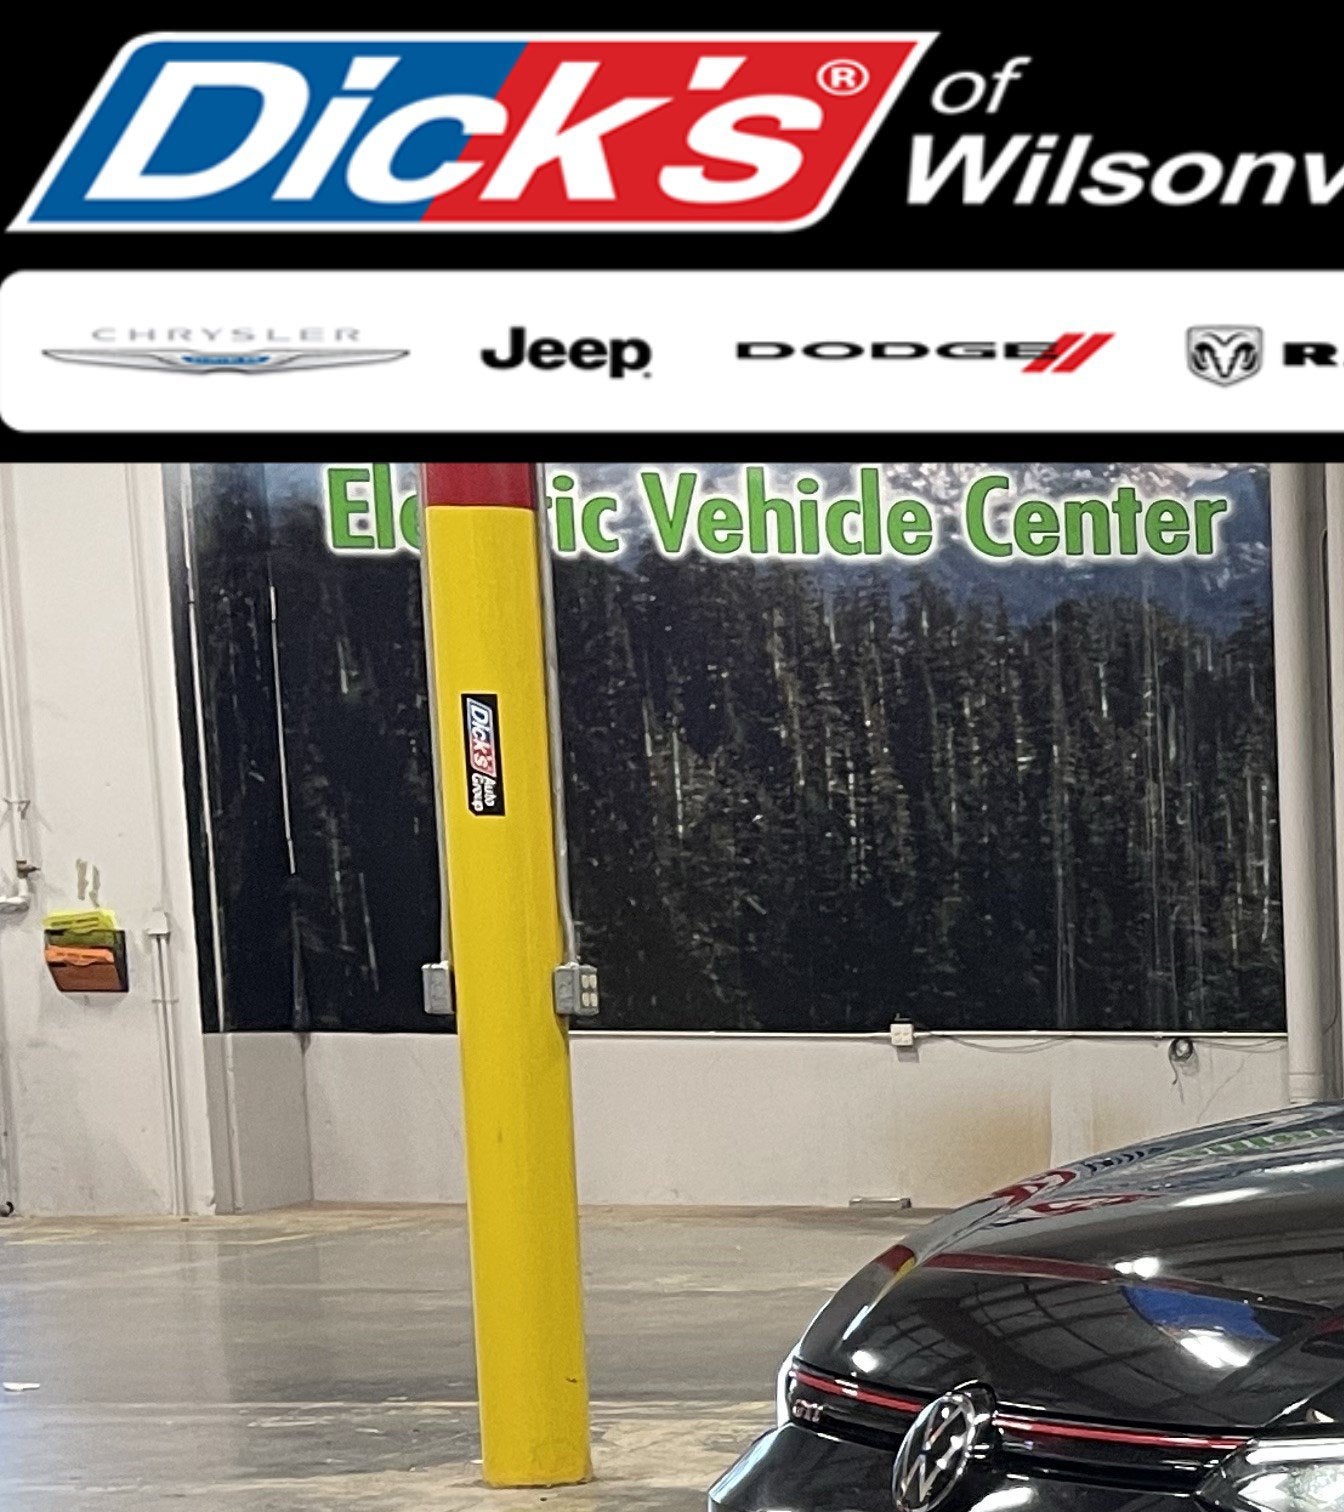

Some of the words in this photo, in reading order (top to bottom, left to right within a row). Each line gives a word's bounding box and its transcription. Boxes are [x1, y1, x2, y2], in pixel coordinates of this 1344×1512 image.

[327, 462, 620, 553] Elic
[641, 466, 933, 556] Vehicle
[965, 475, 1228, 557] Center
